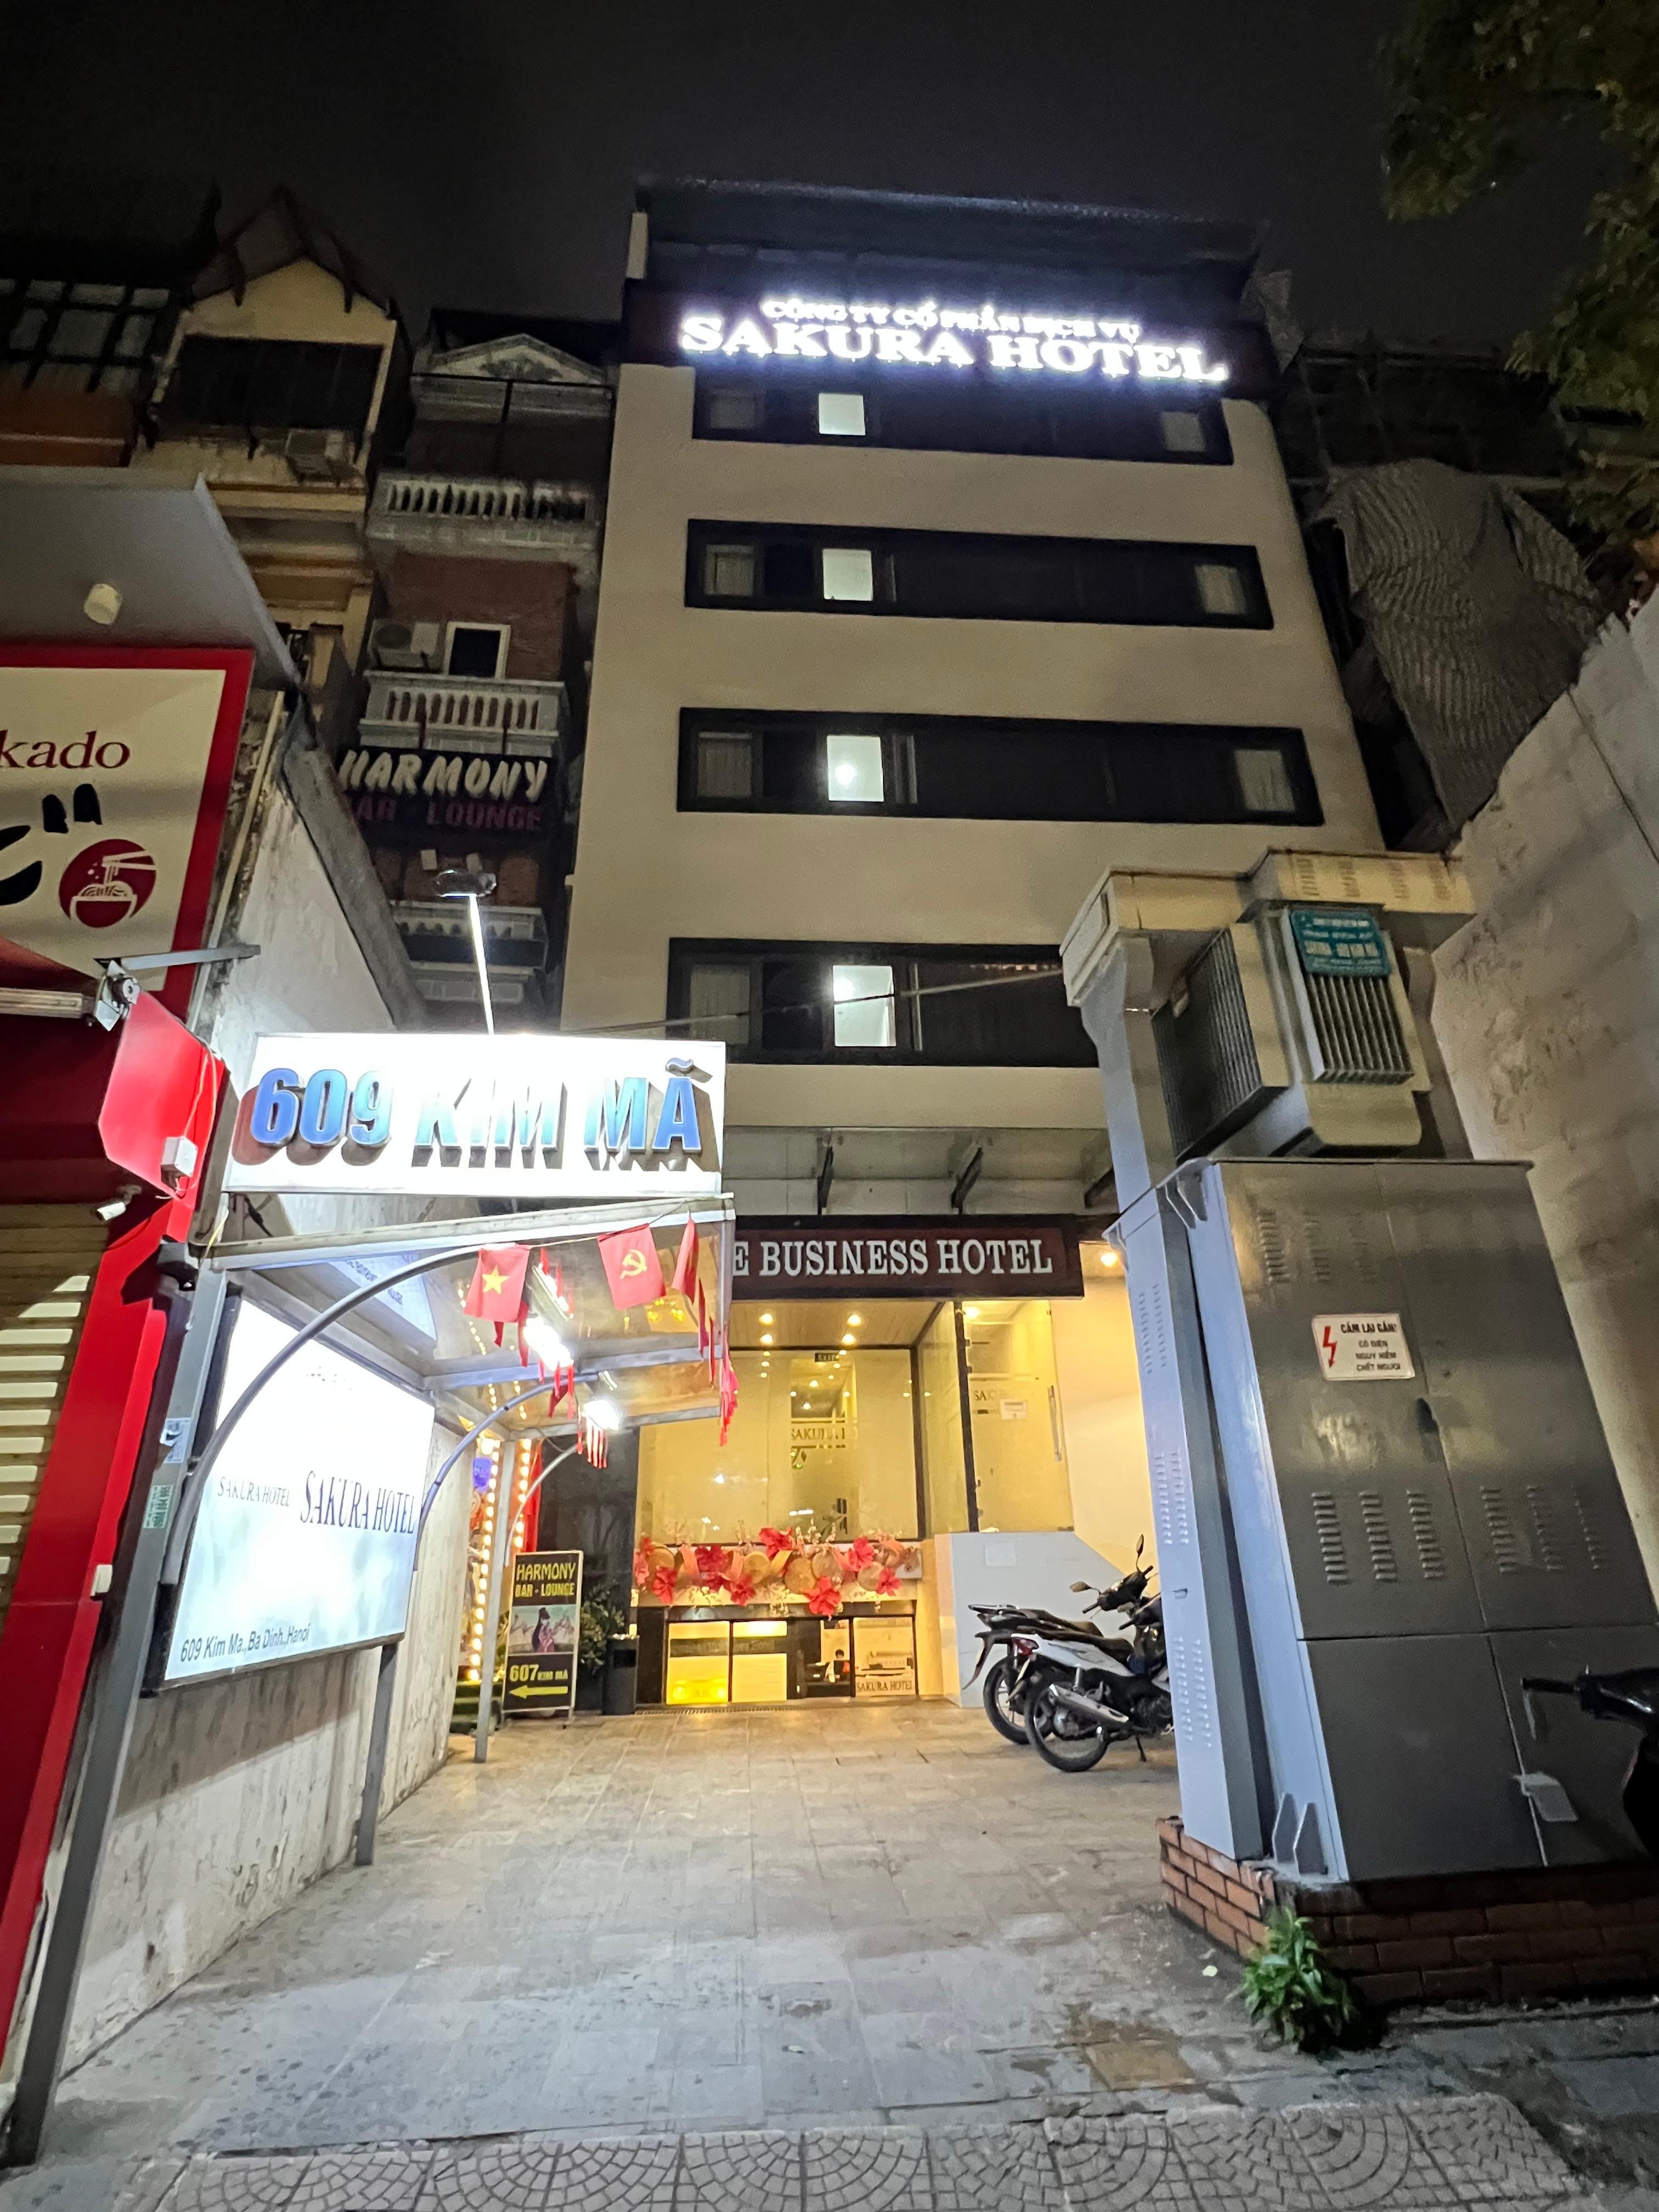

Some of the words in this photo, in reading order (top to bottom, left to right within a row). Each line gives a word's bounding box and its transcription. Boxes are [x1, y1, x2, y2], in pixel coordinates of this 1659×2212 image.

[681, 316, 975, 367] SAKURA
[987, 335, 1228, 382] HOTEL
[337, 749, 548, 803] HARMONY
[250, 1066, 393, 1149] 609
[414, 1076, 568, 1153] KIM
[584, 1057, 702, 1154] MÃ
[759, 1239, 928, 1277] BUSINESS
[936, 1238, 1053, 1276] HOTEL
[217, 1476, 260, 1502] SAKURA
[261, 1486, 290, 1507] HOTEL
[300, 1470, 370, 1530] SAKURA
[371, 1487, 417, 1534] HOTEL
[516, 1562, 577, 1581] HARMONY
[515, 1584, 533, 1598] BAR
[541, 1583, 575, 1597] LOUNGE
[180, 1637, 203, 1663] 609
[203, 1635, 226, 1660] Kim
[509, 1664, 539, 1682] 607
[857, 1680, 888, 1692] SAKURA
